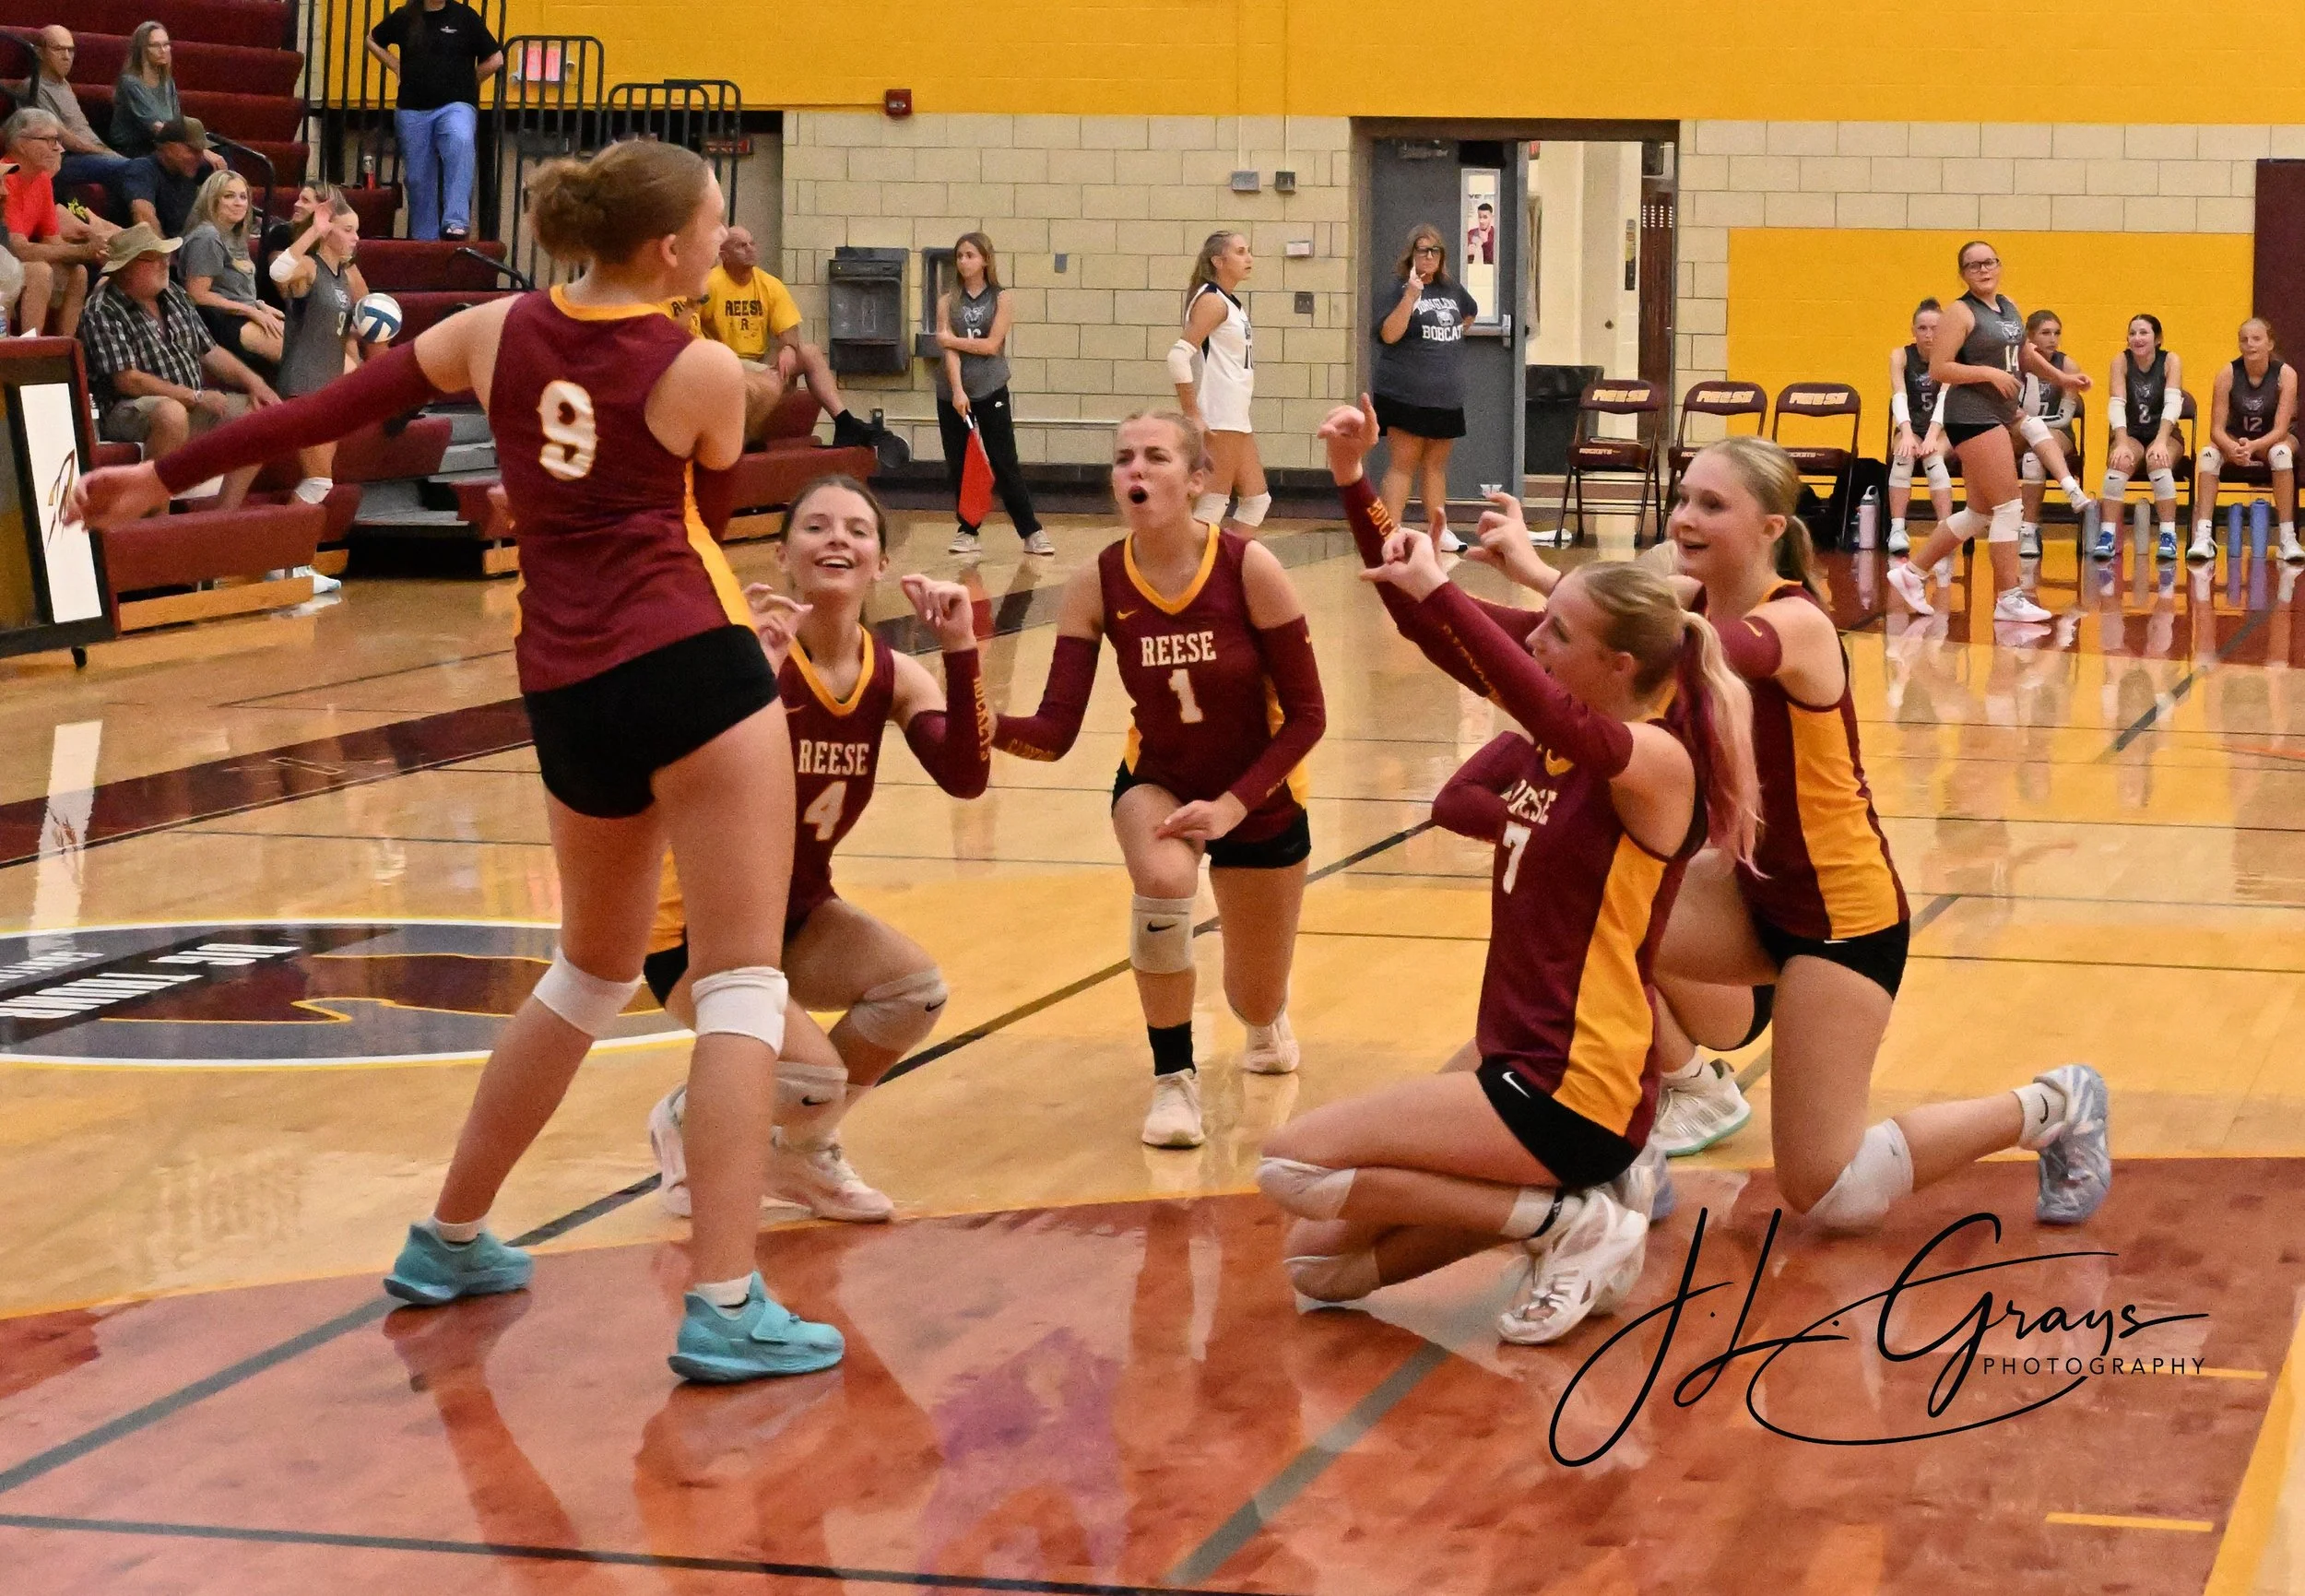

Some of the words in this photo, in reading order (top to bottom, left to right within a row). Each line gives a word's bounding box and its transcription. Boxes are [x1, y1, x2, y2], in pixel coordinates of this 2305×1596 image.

[337, 311, 347, 337] 9
[2004, 345, 2020, 372] 14
[1921, 392, 1934, 412] 5
[2138, 403, 2151, 424] 2
[536, 379, 597, 481] 9
[2243, 416, 2264, 432] 12
[1141, 631, 1217, 668] REESE
[1168, 668, 1204, 724] 1
[798, 739, 870, 776] REESE
[803, 780, 848, 842] 4
[1502, 821, 1532, 894] 7
